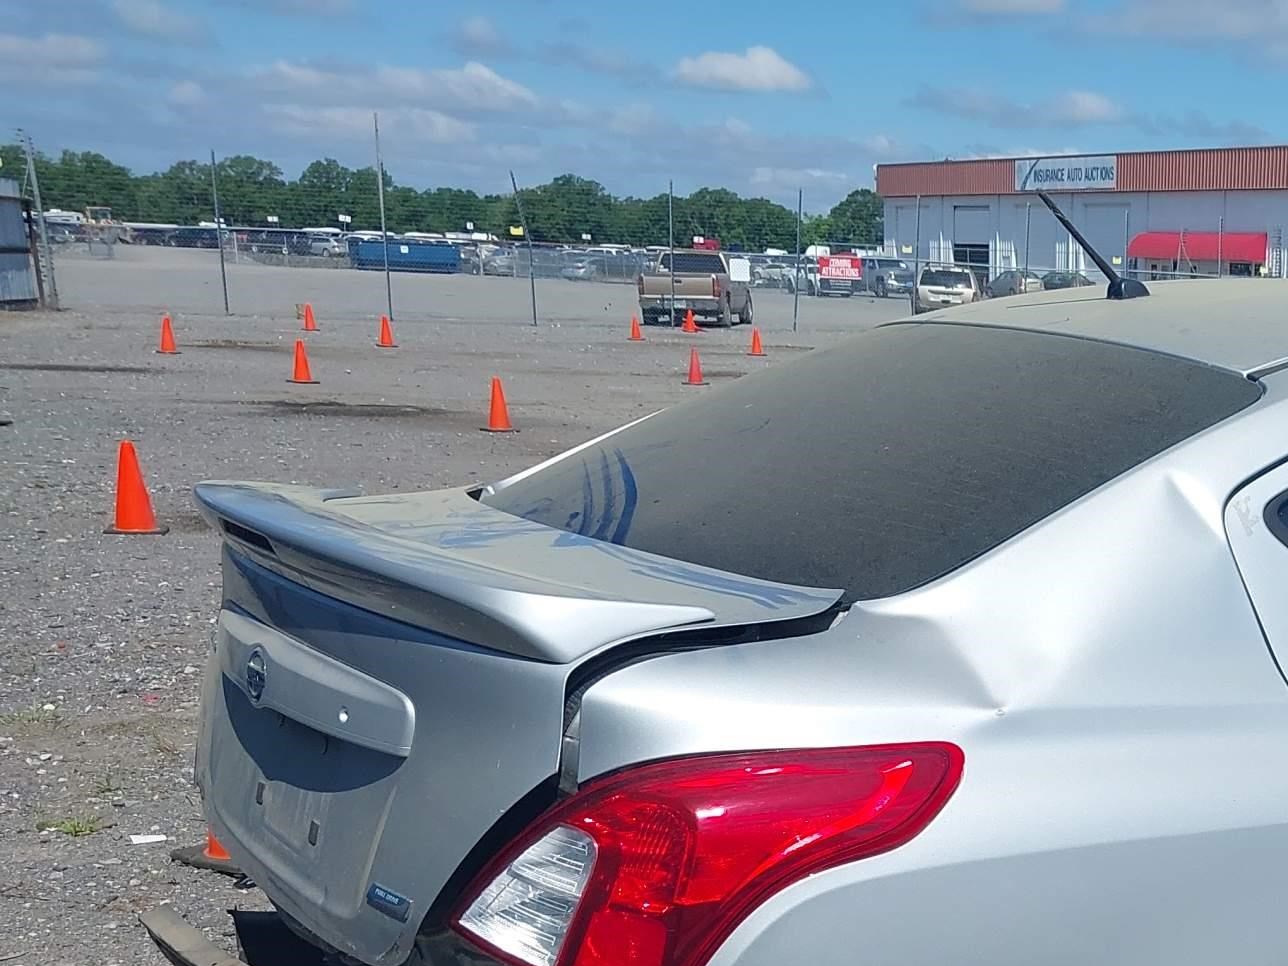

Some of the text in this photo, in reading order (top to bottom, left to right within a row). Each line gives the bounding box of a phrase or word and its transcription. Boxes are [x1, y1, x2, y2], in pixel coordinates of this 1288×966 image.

[1033, 166, 1114, 183] INSURANCE AUTO AUCTIONS
[829, 258, 852, 268] COMING
[821, 266, 859, 277] ATTRACTIONS
